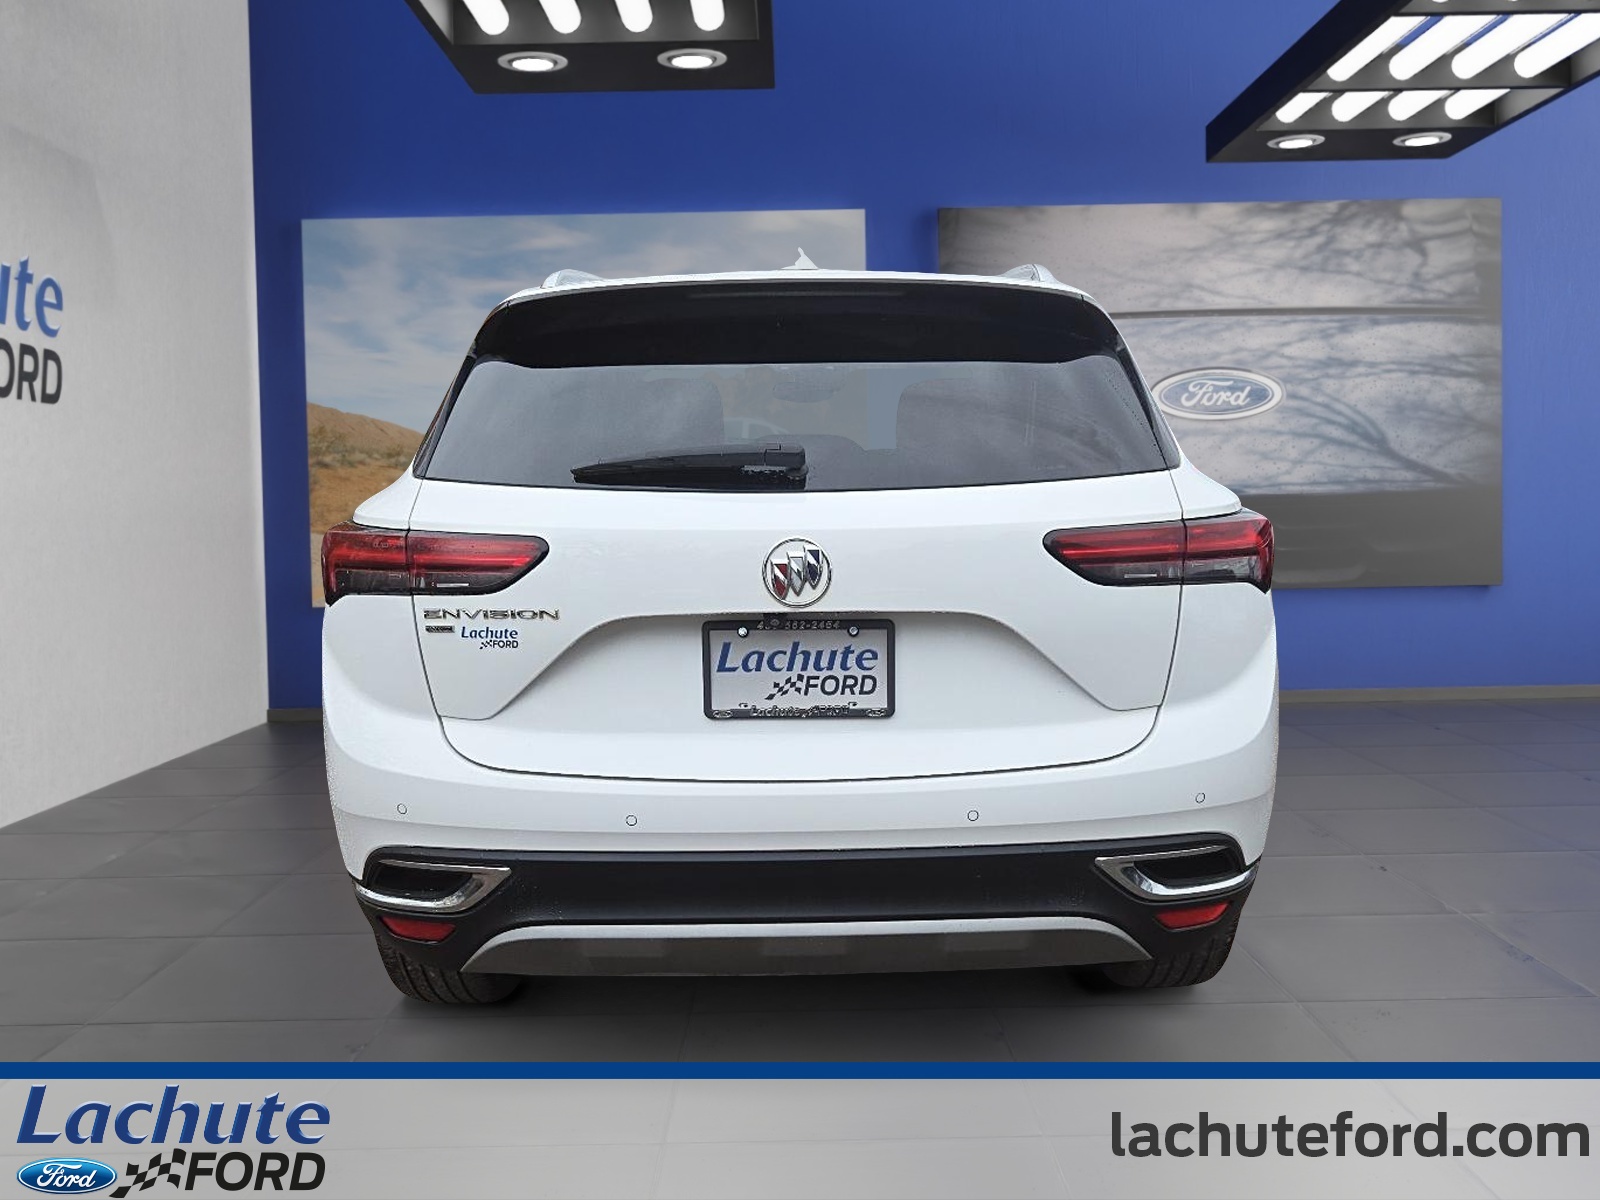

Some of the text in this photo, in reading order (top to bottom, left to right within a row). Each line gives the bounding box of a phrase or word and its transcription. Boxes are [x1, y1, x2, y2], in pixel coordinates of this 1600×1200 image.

[1181, 379, 1252, 407] Ford
[423, 608, 560, 620] ENVISION
[461, 626, 519, 640] Lachute
[492, 640, 519, 649] FORD
[716, 641, 879, 673] Lachute
[803, 674, 878, 697] FORD
